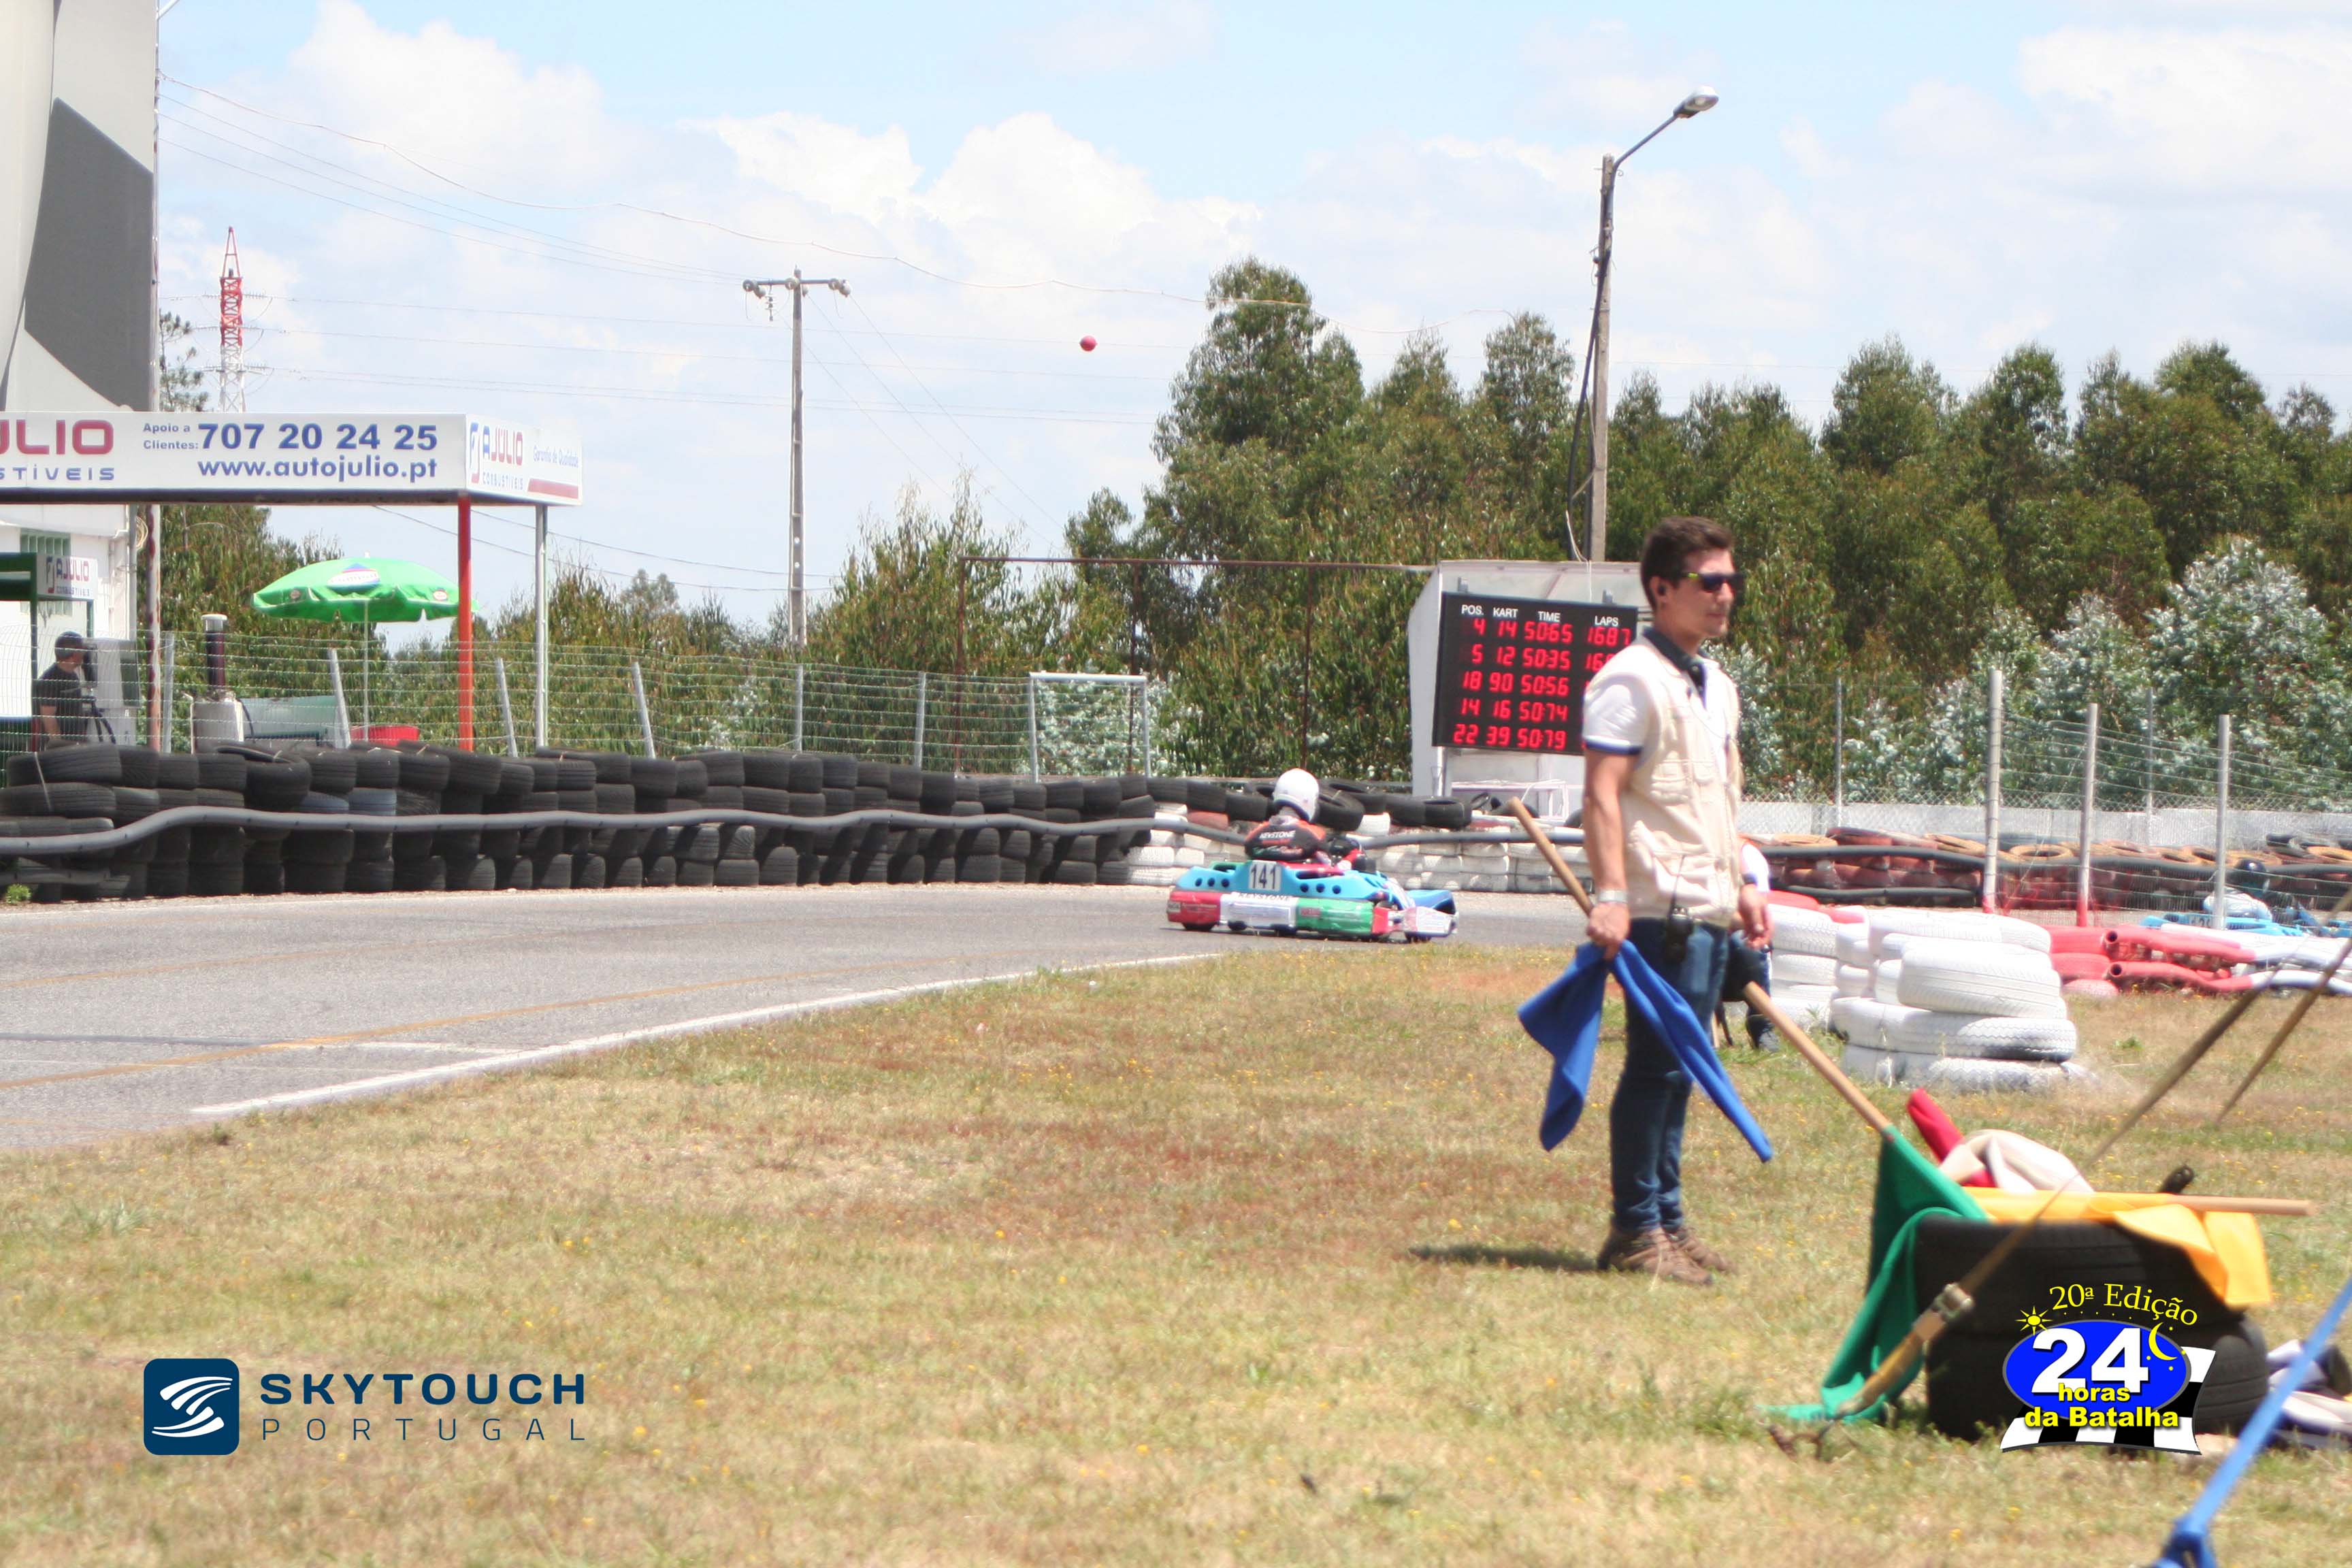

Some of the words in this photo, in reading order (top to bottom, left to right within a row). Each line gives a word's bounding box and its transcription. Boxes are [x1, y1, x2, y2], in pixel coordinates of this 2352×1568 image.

[0, 419, 114, 455] LIO
[143, 422, 179, 434] Apoio
[197, 423, 265, 449] 707
[278, 423, 323, 450] 20
[336, 423, 380, 450] 24
[393, 424, 438, 451] 25
[143, 440, 199, 450] Clientes:
[197, 454, 438, 483] www.autojulio.pt
[1461, 604, 1484, 615] POS.
[1492, 607, 1518, 618] KART
[1537, 610, 1561, 622] TIME
[1595, 615, 1619, 627] LAPS
[1473, 618, 1486, 636] 4
[1498, 620, 1518, 638] 14
[1587, 626, 1632, 647] 1687
[1471, 643, 1484, 664] 5
[1496, 646, 1516, 666] 12
[1585, 652, 1616, 672] 16
[1463, 670, 1483, 691] 18
[1488, 672, 1514, 693] 90
[1461, 698, 1481, 717] 14
[1492, 699, 1512, 719] 16
[1453, 723, 1479, 745] 22
[1486, 725, 1510, 747] 39
[1259, 830, 1296, 839] KEYSTONE
[1250, 864, 1277, 890] 141
